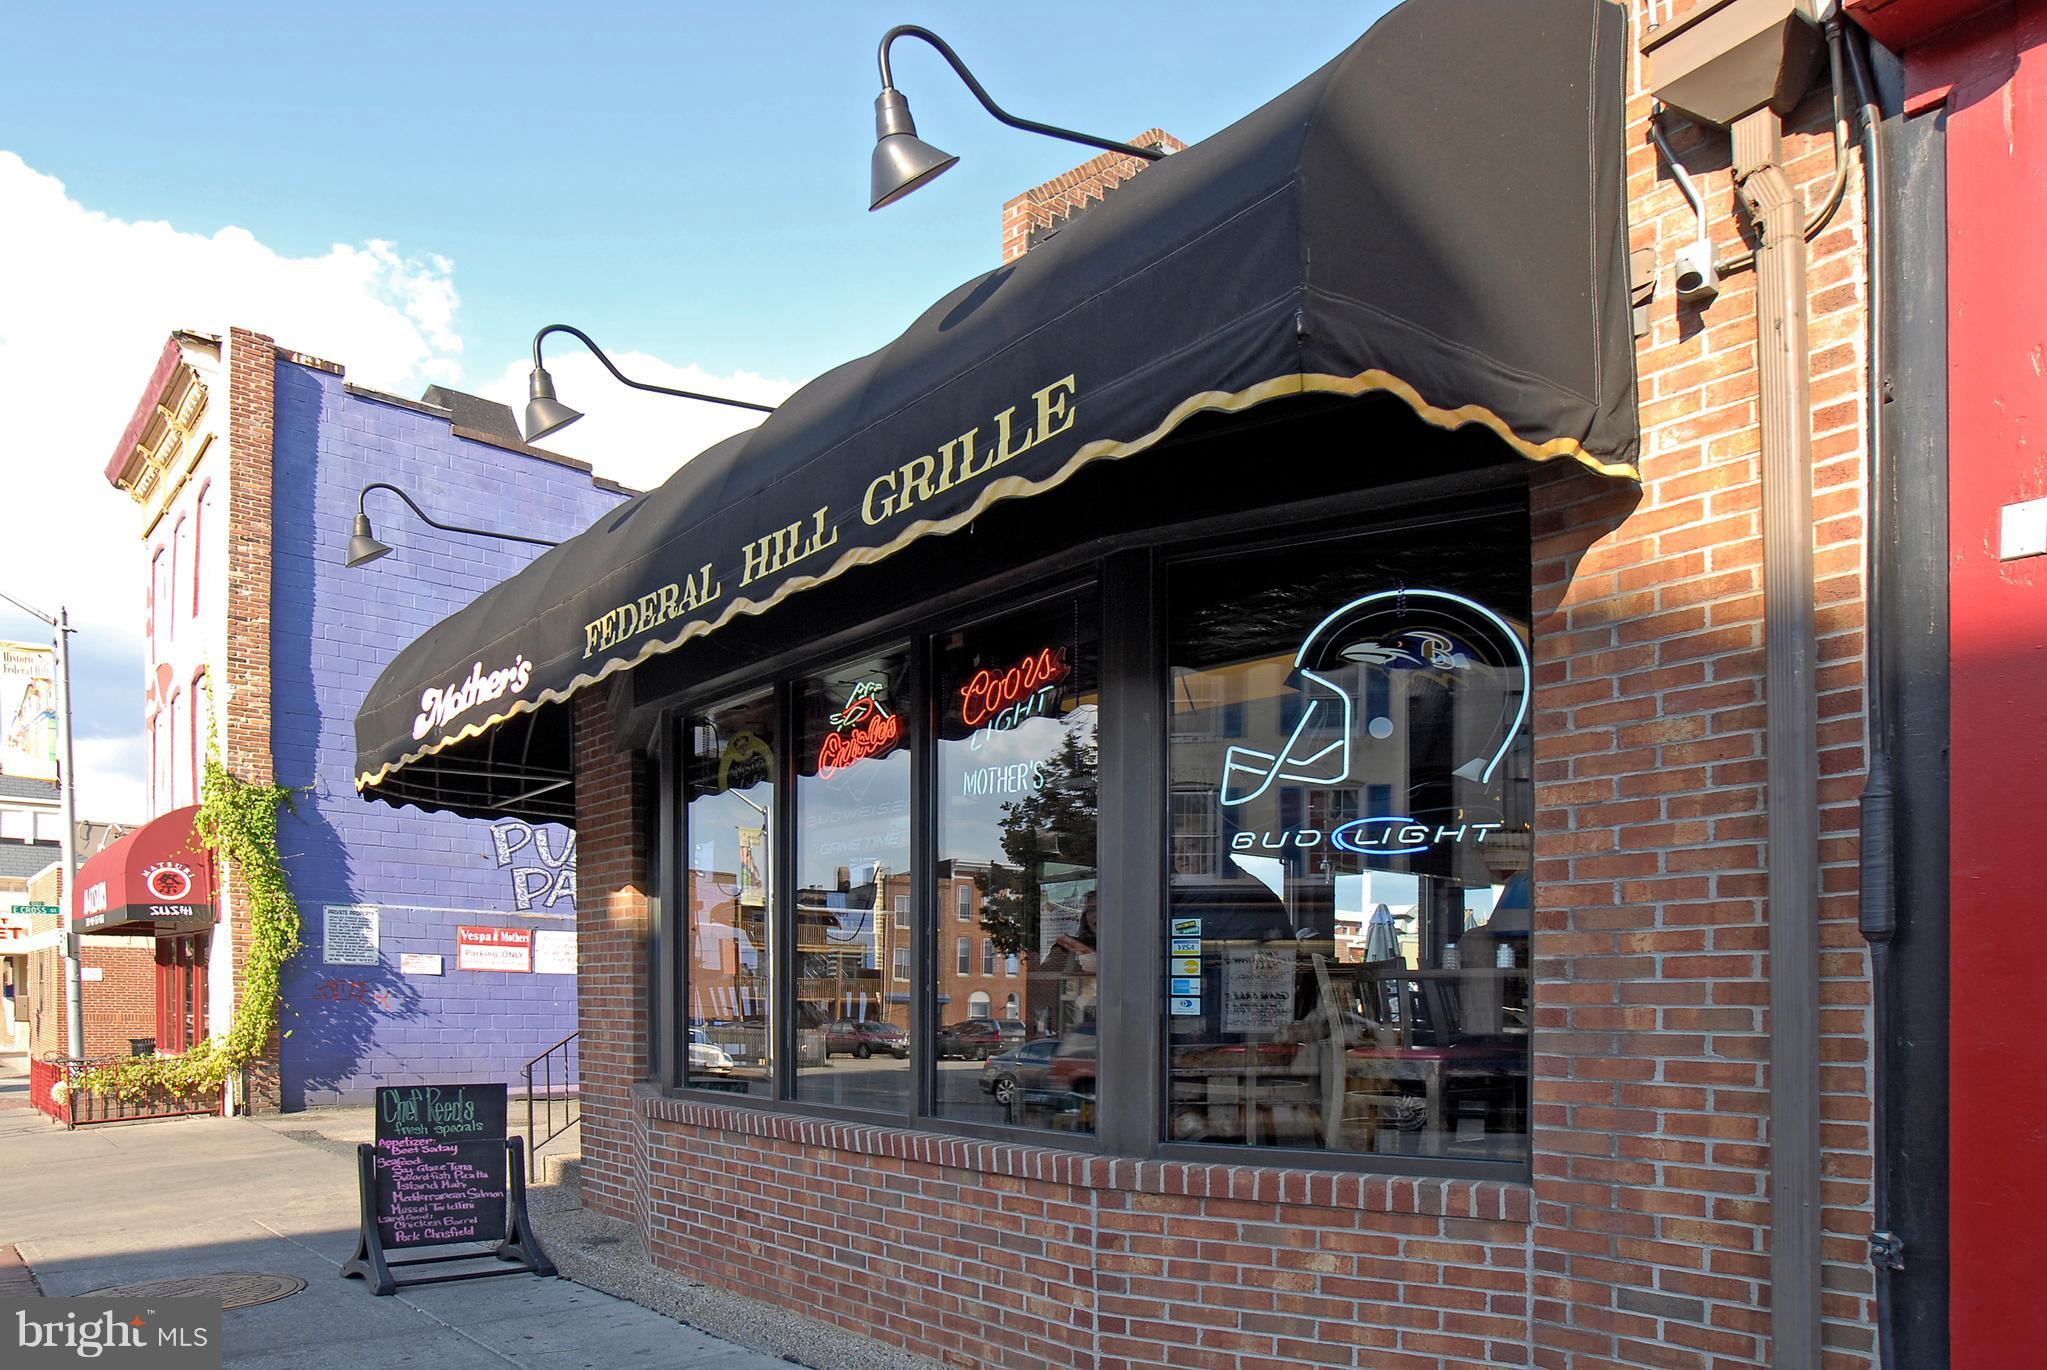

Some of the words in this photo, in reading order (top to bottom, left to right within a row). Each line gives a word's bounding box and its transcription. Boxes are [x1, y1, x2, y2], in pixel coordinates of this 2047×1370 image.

[582, 561, 722, 660] FEDERAL
[739, 505, 838, 588] HILL
[860, 373, 1077, 527] GRILLE
[960, 647, 1057, 726] Coors
[412, 653, 533, 741] Mother's
[971, 685, 1054, 751] LIGHT
[818, 713, 898, 780] Orioles
[962, 760, 1045, 797] MOTHER'S
[1231, 829, 1322, 850] BUD
[1354, 823, 1502, 846] LIGHT
[141, 861, 196, 878] MATSURI
[20, 906, 47, 915] CROSS
[149, 905, 193, 916] SUSHI
[460, 929, 492, 943] Vespa
[465, 949, 499, 959] Parking
[501, 951, 524, 959] ONLY
[383, 1089, 423, 1122] Chef
[426, 1087, 475, 1124] Reed's
[394, 1121, 428, 1135] fresh
[433, 1119, 484, 1137] specials
[421, 1144, 459, 1156] Satay
[446, 1162, 473, 1171] Tuna
[395, 1180, 439, 1191] Island
[466, 1187, 504, 1200] Salmon
[391, 1203, 428, 1215] Mussel
[393, 1219, 442, 1231] Chicken
[395, 1230, 421, 1242] Pork
